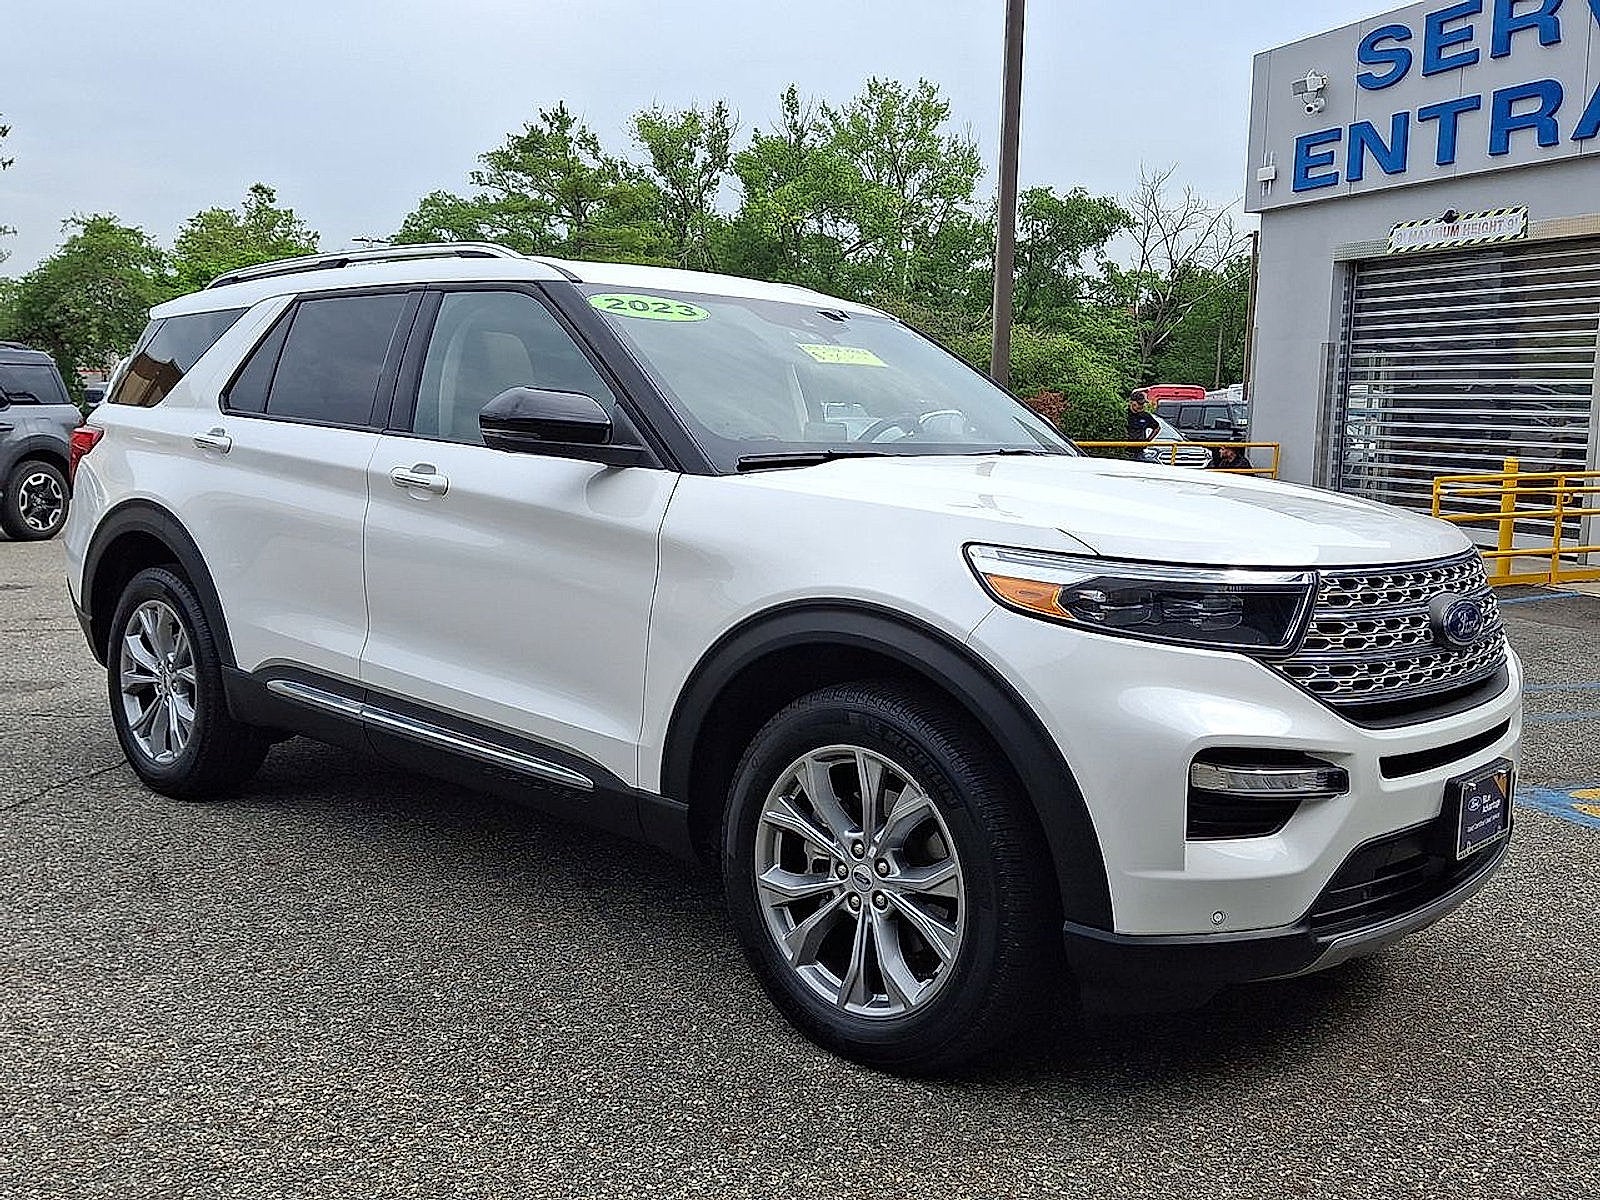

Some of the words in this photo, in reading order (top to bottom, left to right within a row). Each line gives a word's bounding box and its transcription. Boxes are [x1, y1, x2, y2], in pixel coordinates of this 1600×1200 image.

[1356, 0, 1600, 91] SER
[1462, 218, 1505, 237] HEIGHT
[604, 297, 698, 317] 2023
